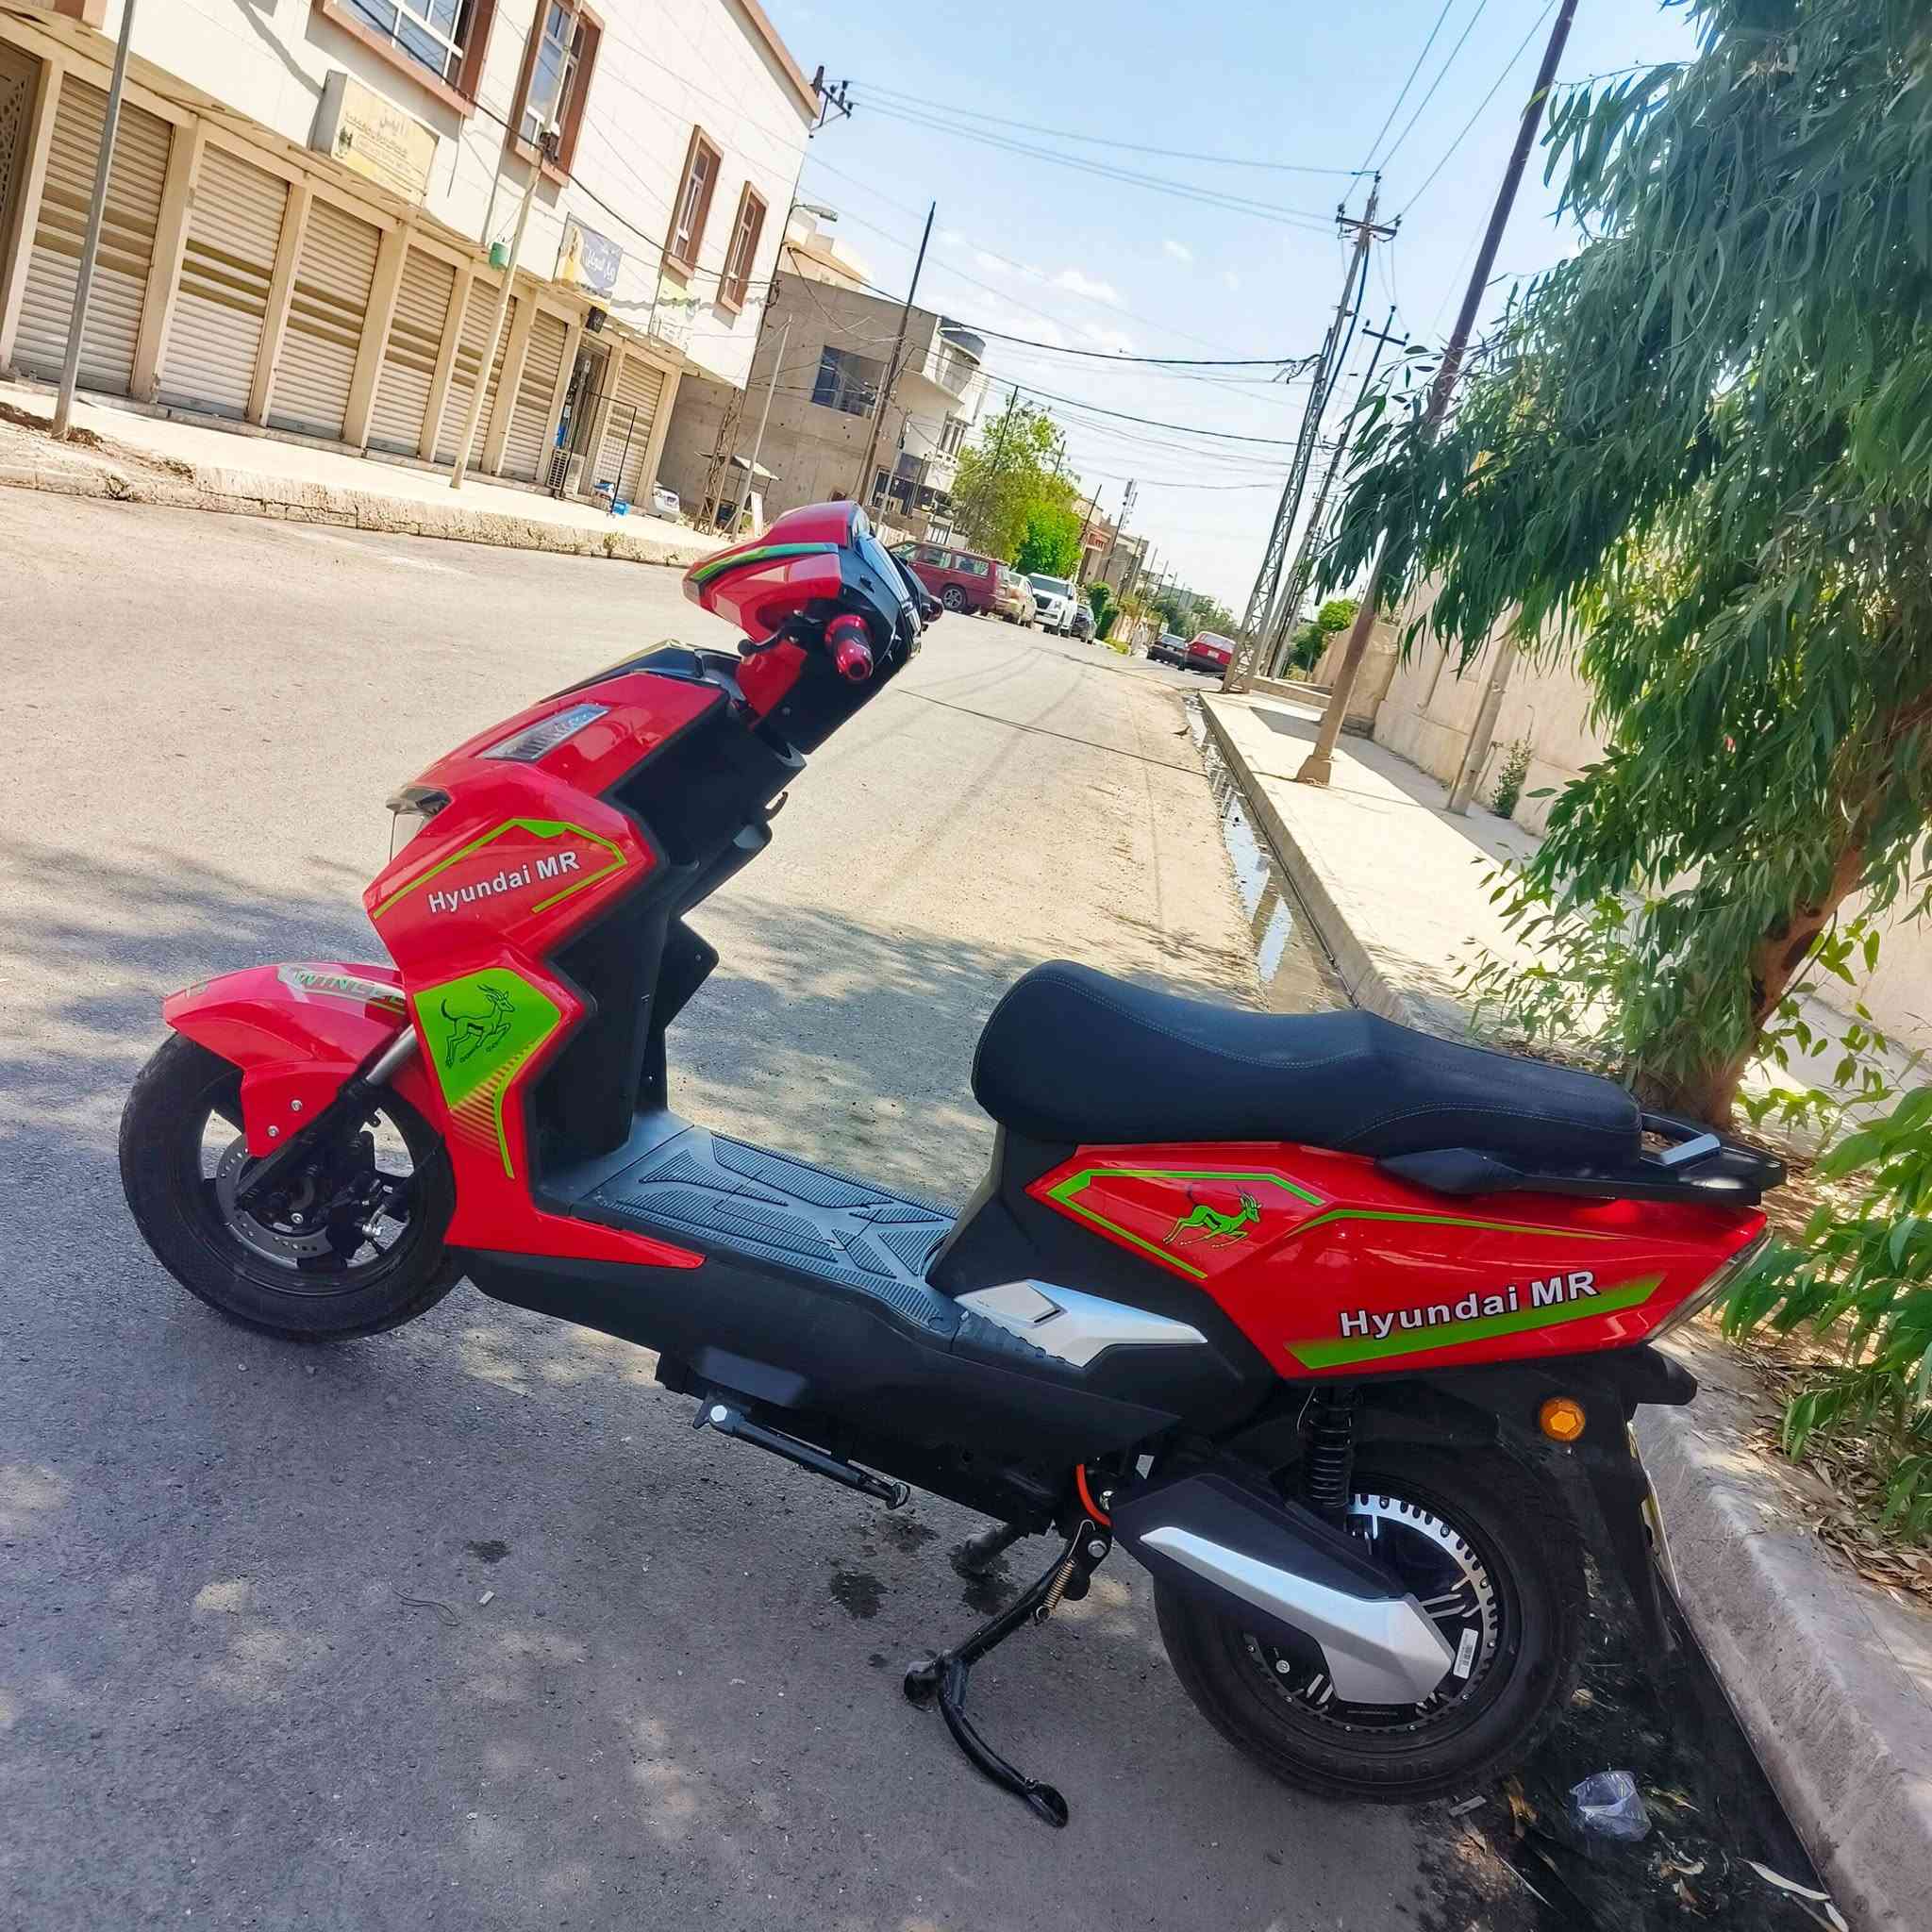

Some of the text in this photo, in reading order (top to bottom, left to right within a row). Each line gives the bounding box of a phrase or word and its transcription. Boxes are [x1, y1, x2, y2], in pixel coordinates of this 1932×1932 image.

[427, 851, 581, 913] Hyundai MR
[1339, 1270, 1601, 1341] Hyundai MR
